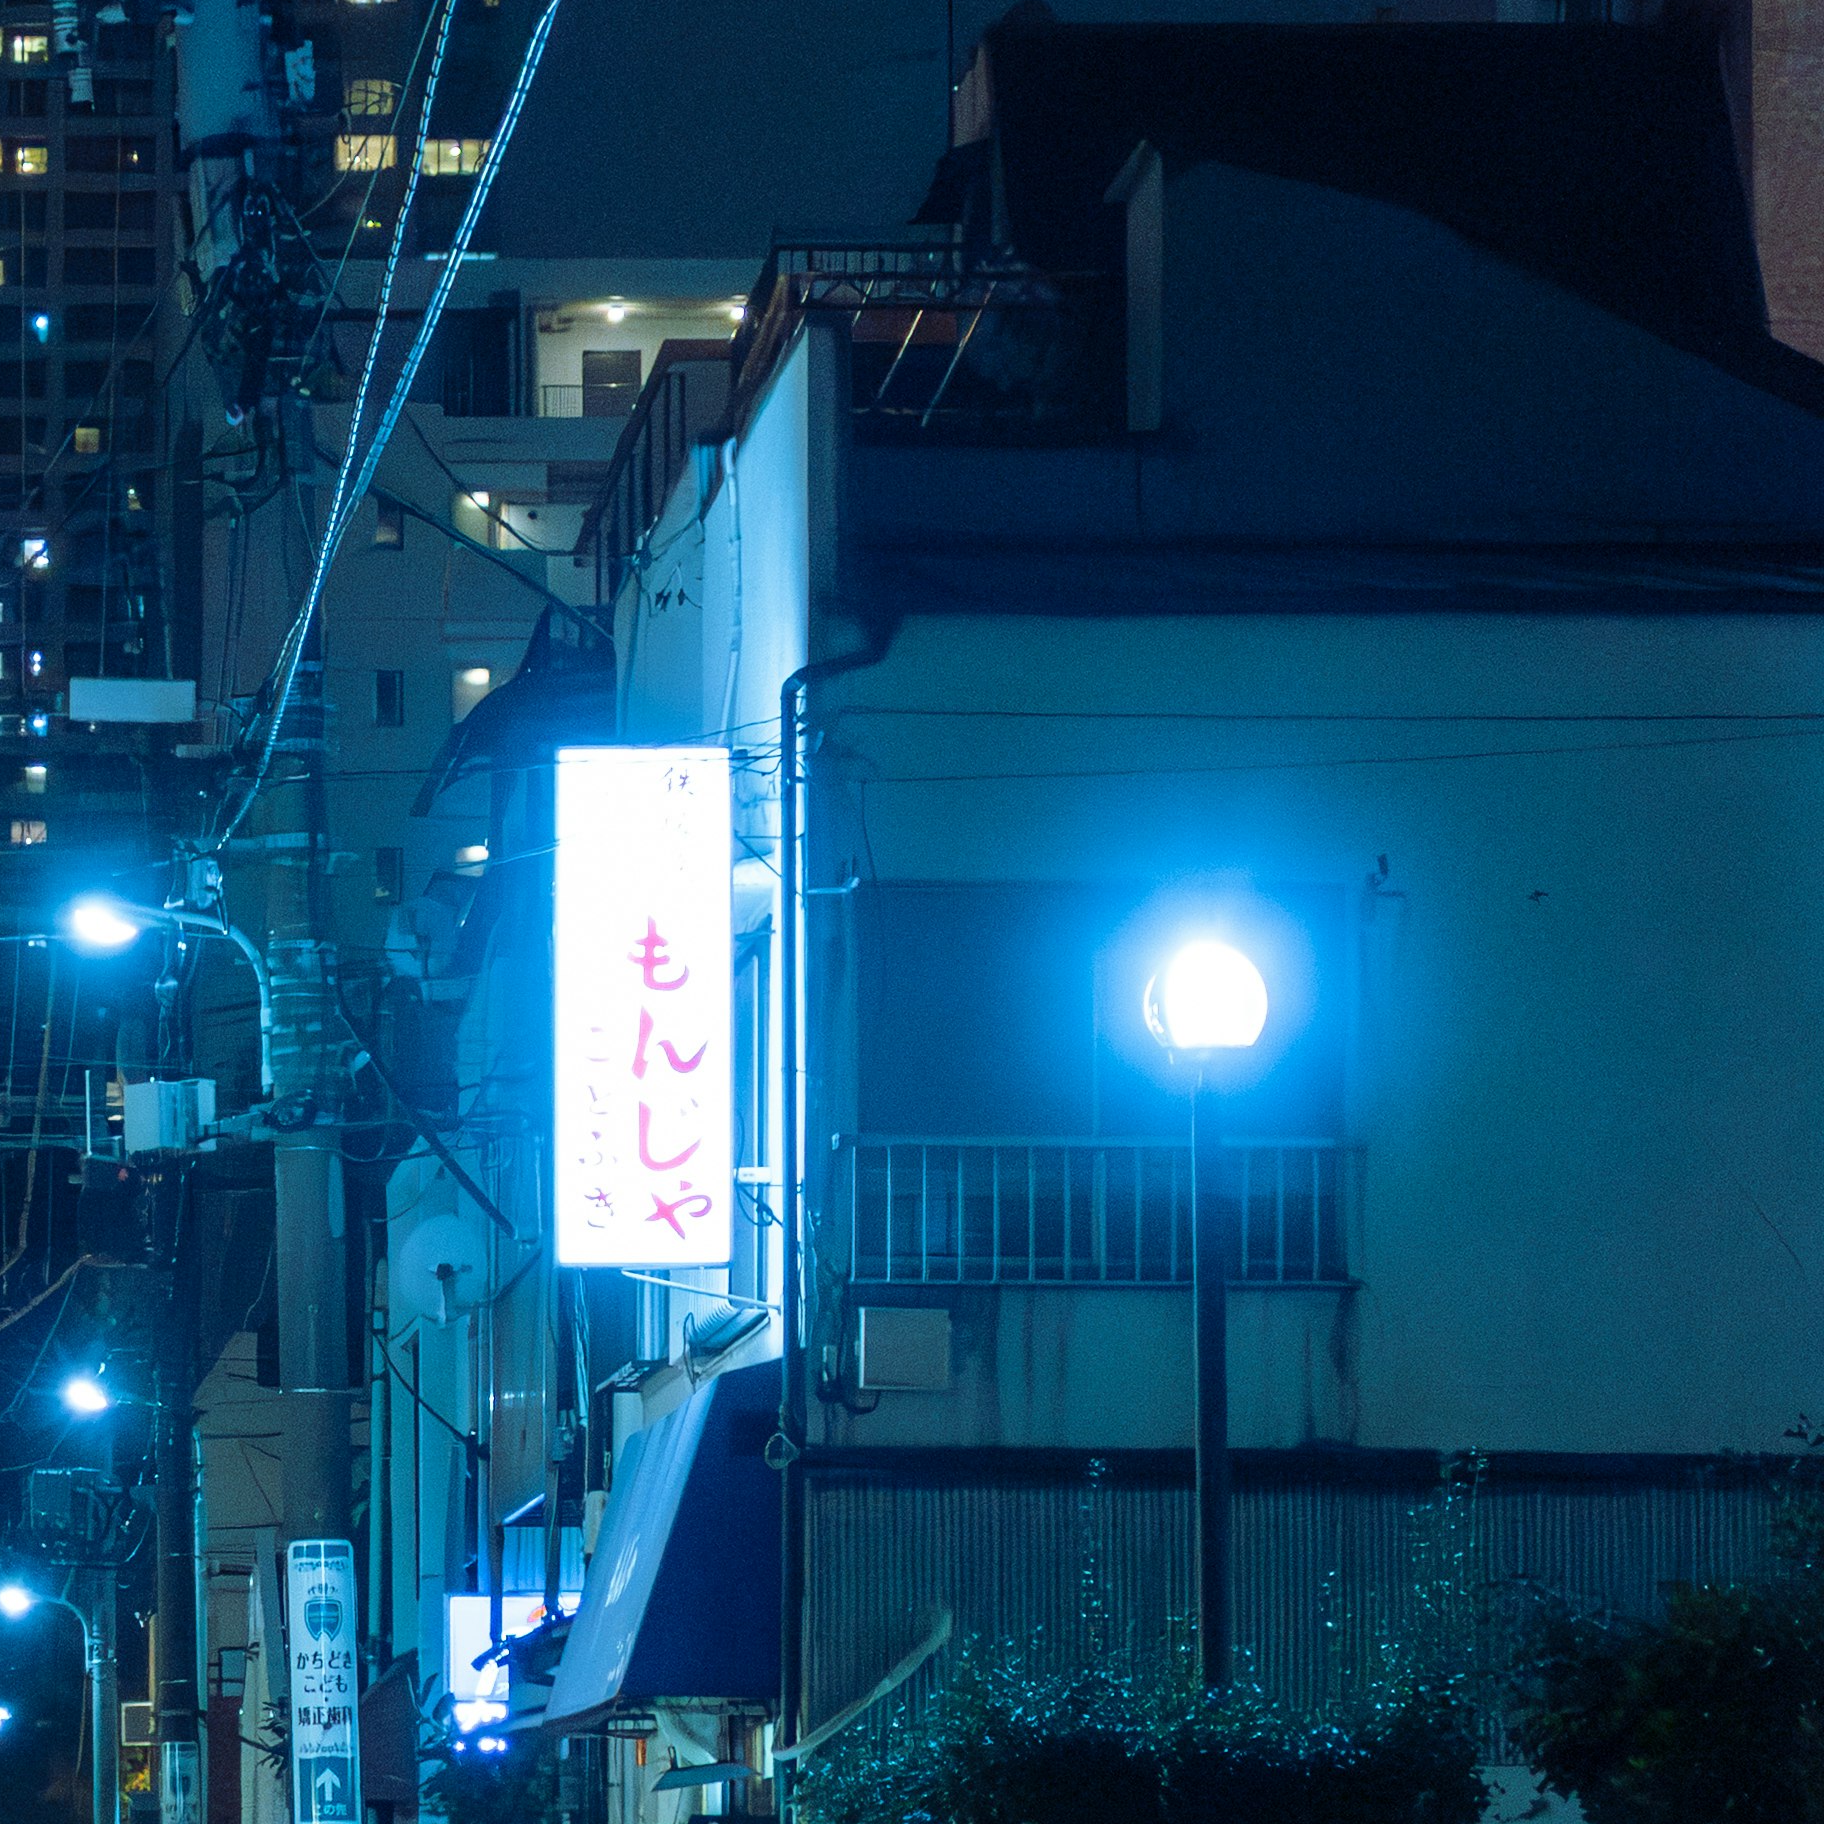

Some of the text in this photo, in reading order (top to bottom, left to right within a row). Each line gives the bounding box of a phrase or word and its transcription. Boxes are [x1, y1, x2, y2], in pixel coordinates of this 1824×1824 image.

[297, 1650, 352, 1670] かちどき
[304, 1674, 348, 1693] こども
[298, 1706, 352, 1726] 矯正歯科
